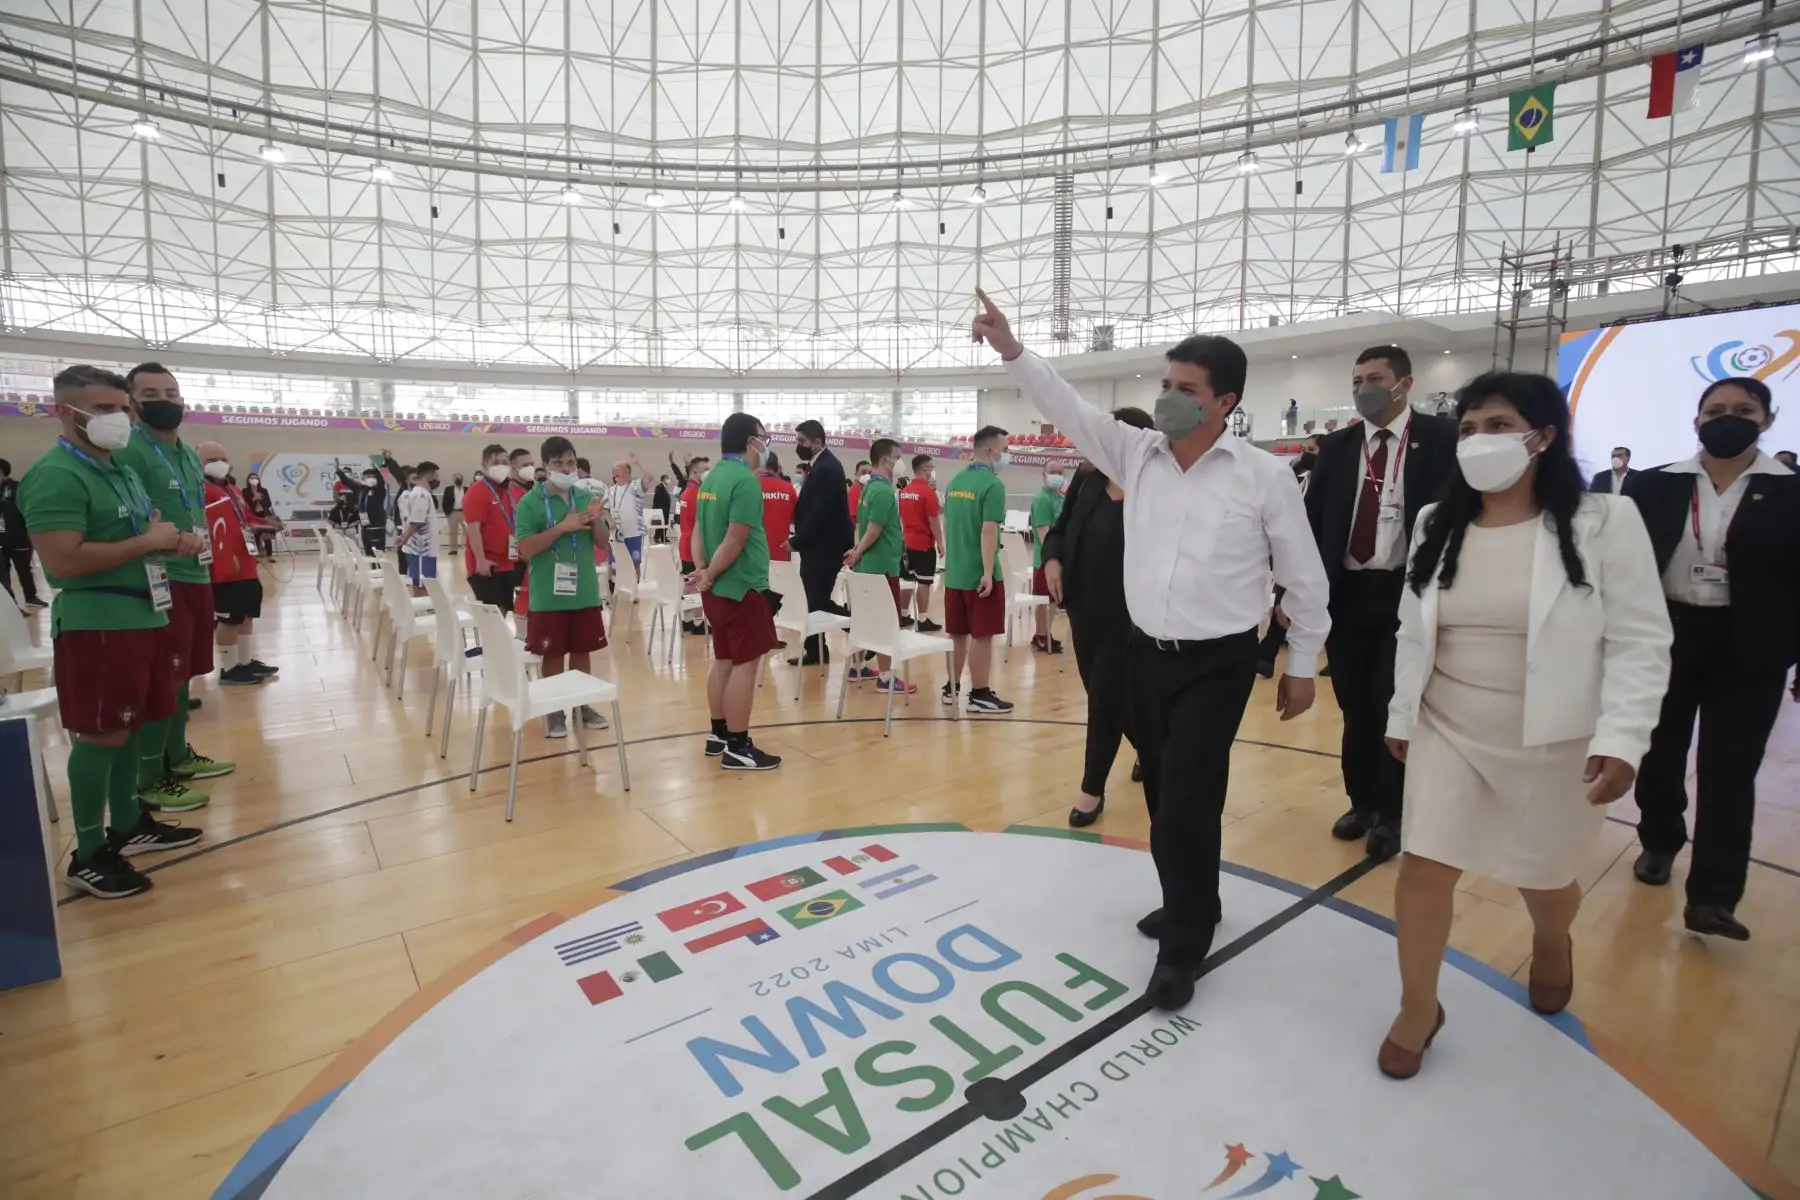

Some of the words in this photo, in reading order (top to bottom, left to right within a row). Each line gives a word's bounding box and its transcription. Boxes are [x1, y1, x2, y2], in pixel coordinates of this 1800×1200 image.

[222, 415, 278, 425] SEGUIMOS
[280, 418, 328, 427] JUGANDO
[526, 425, 568, 433] SEGUIMOS
[835, 926, 909, 960] LIMA
[748, 957, 830, 996] 2022
[686, 923, 1023, 1098] DOWN
[1099, 1014, 1203, 1082] WORLD
[684, 952, 1130, 1191] FUTSAL
